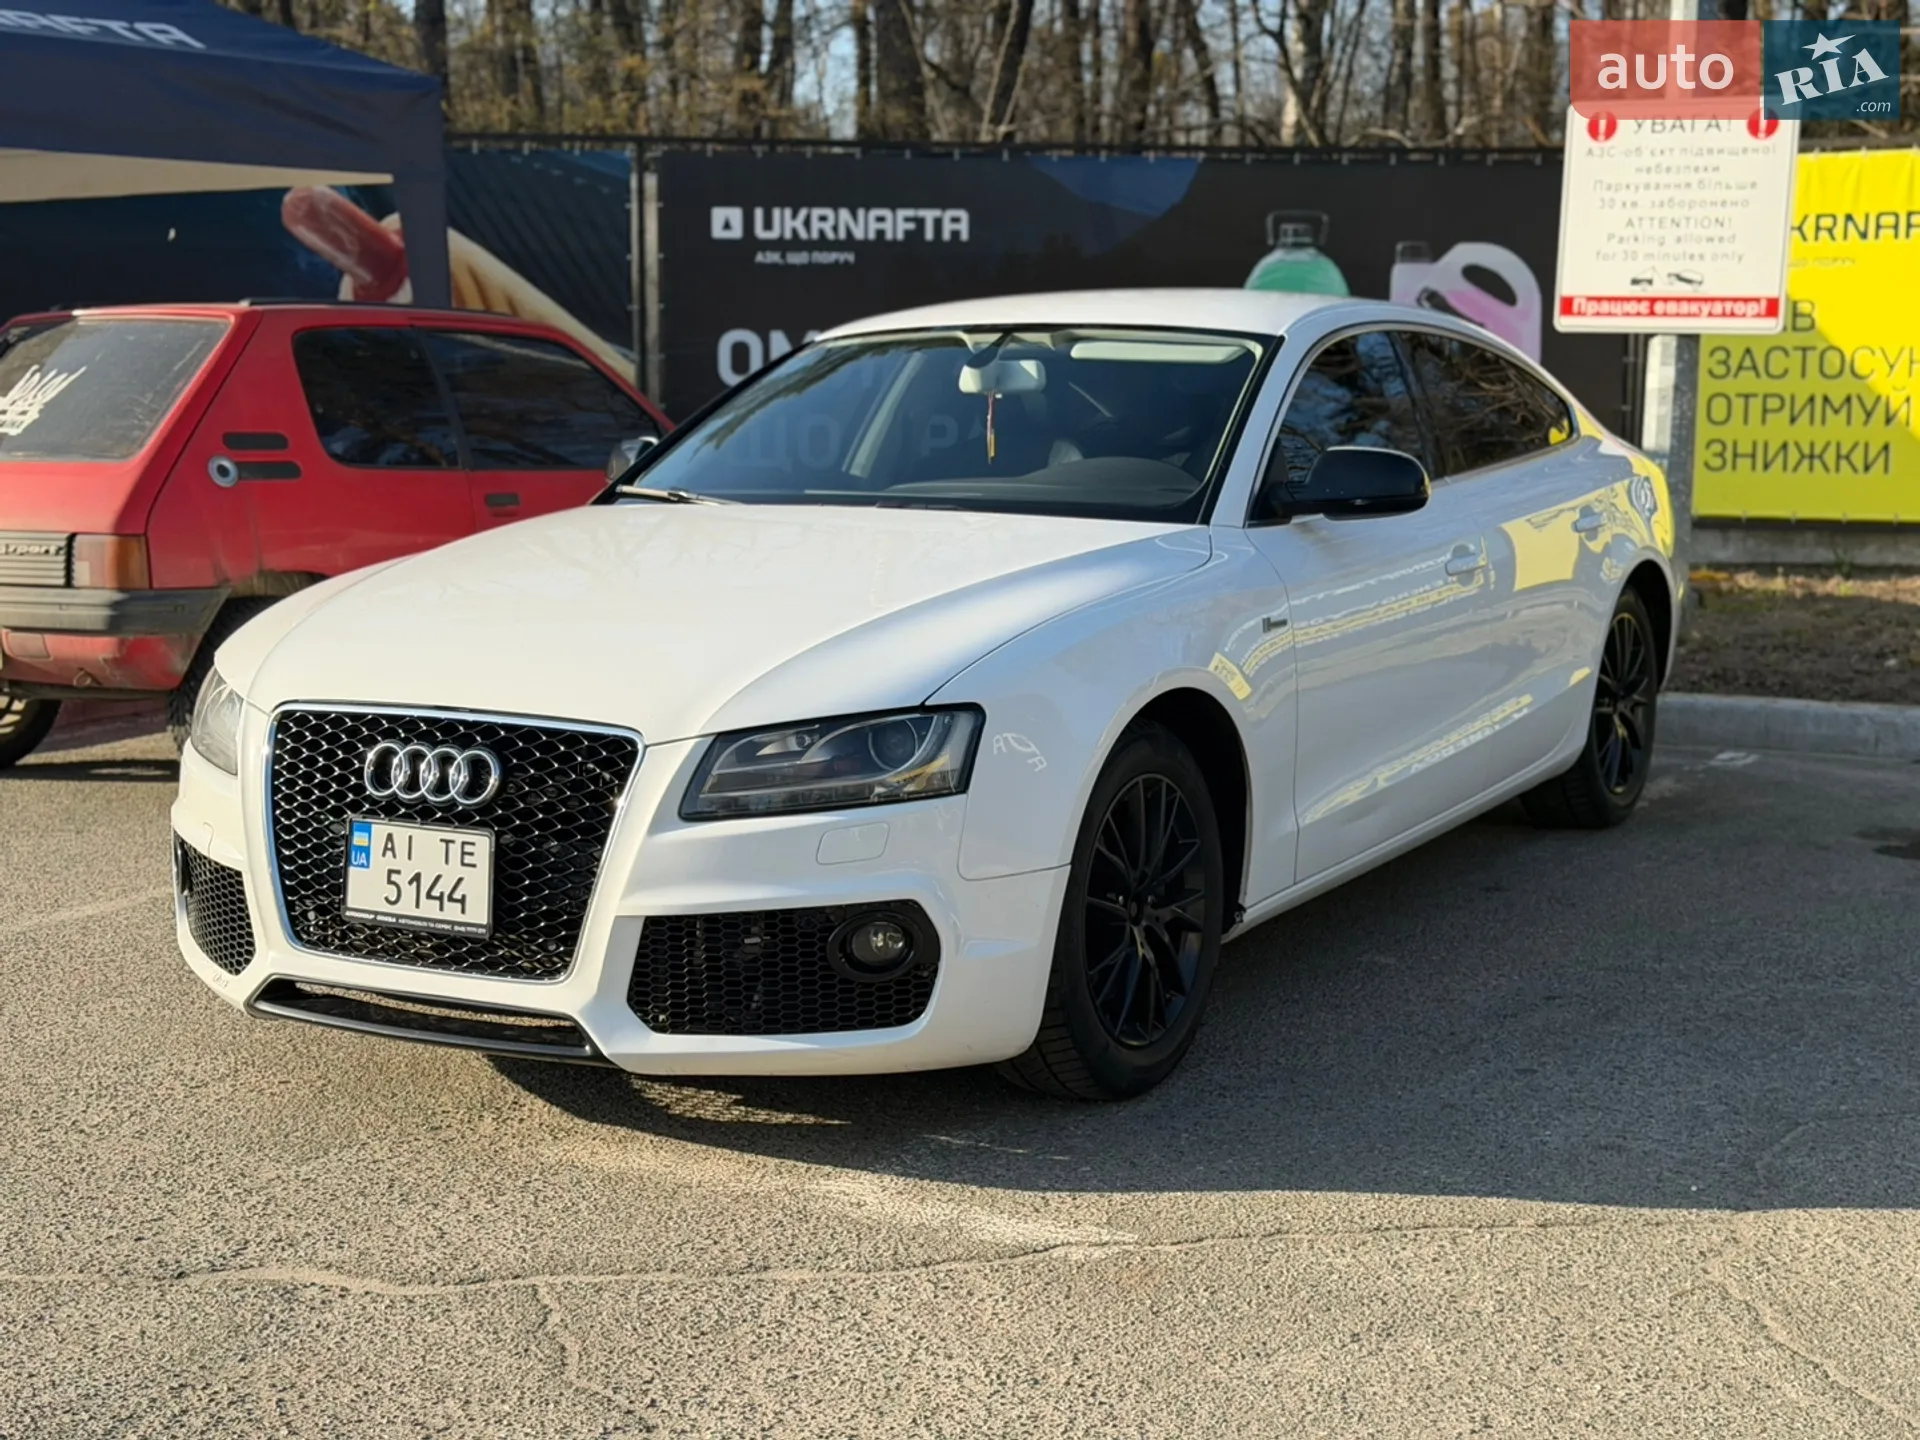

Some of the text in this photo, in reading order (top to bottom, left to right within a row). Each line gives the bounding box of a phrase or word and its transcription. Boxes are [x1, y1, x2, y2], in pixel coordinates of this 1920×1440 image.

[1632, 113, 1732, 134] УВАГА!
[1634, 162, 1721, 175] небезпеки
[1593, 178, 1758, 194] Паркування більше
[1649, 197, 1750, 211] заборонено
[754, 206, 969, 241] UKRNAFTA
[1624, 216, 1733, 230] ATTENTION!
[1606, 233, 1737, 246] Parking allowed
[1596, 249, 1746, 264] for 30 minutes only
[1653, 297, 1768, 318] евакуатор!
[1706, 385, 1911, 427] ОТРИМУЙ
[1703, 438, 1891, 475] ЗНИЖКИ
[351, 851, 368, 867] UA
[381, 832, 477, 868] AI TE
[383, 868, 467, 915] 5144
